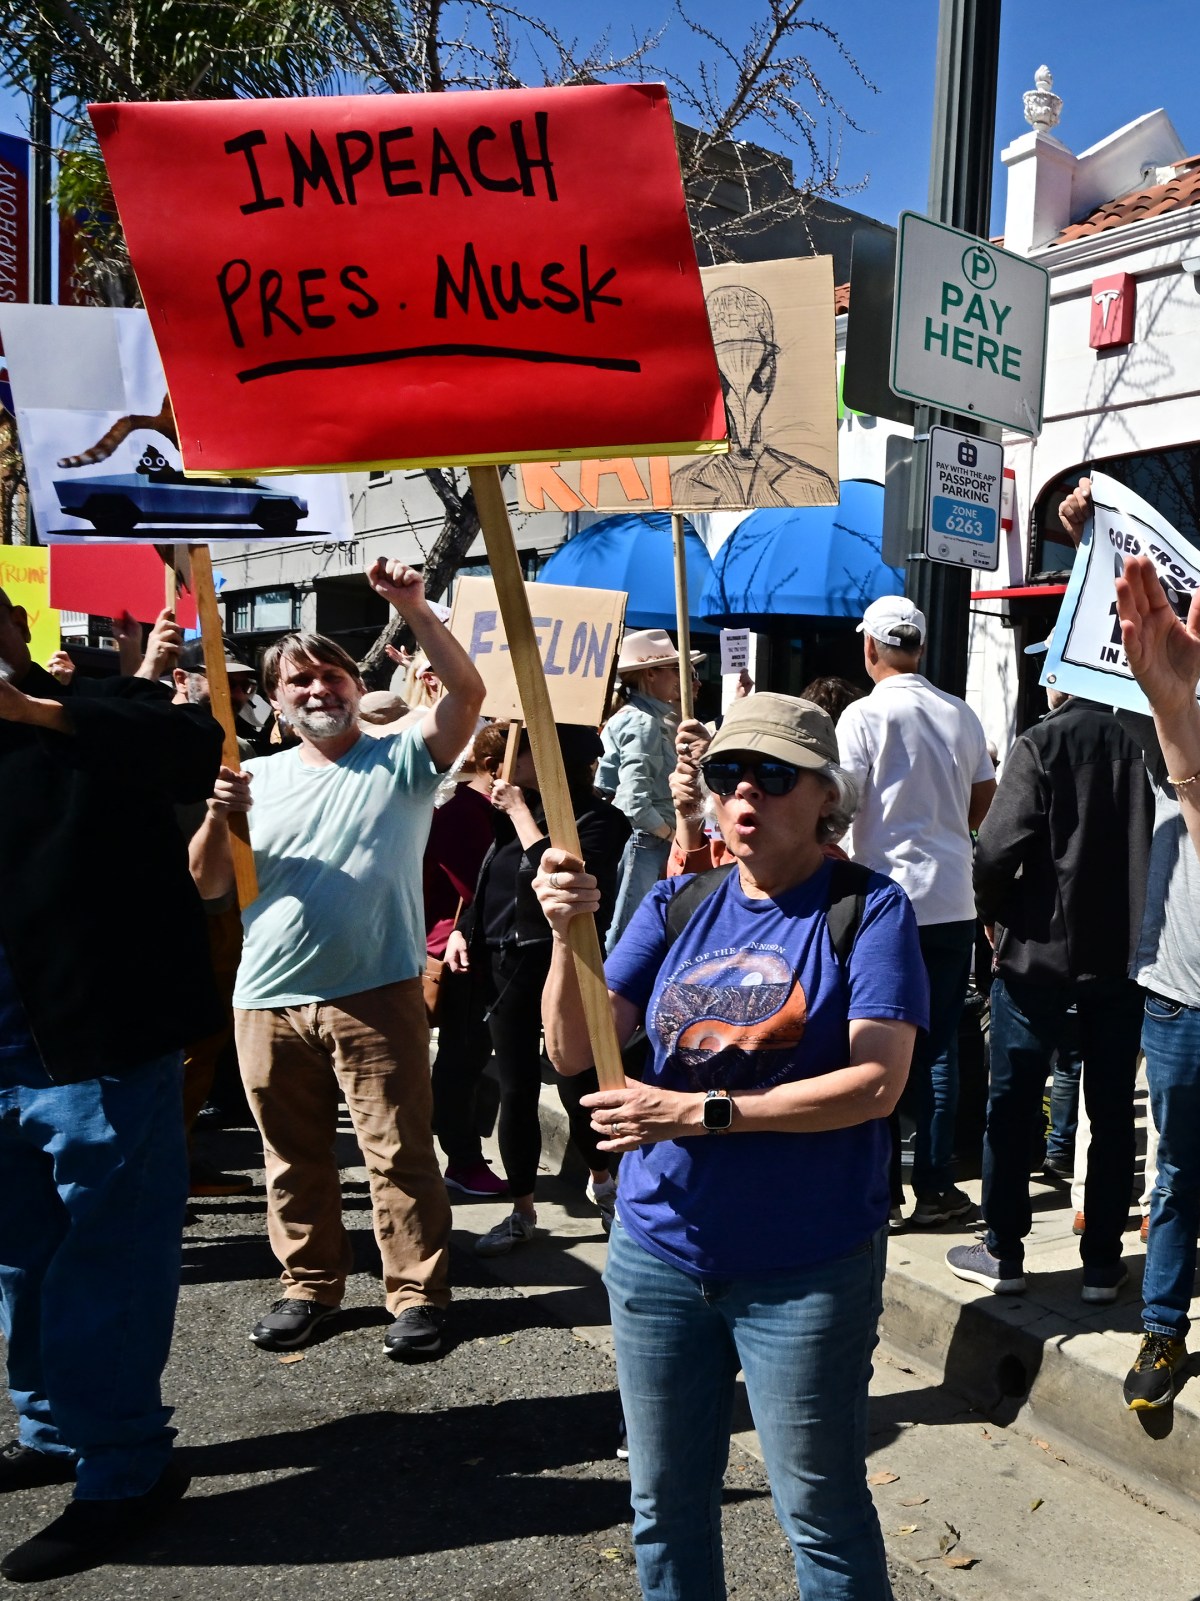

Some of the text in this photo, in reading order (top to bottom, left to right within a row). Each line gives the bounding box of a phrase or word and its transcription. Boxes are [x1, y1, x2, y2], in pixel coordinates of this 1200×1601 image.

[224, 111, 558, 215] IMPEACH
[216, 242, 623, 348] PRES. Musk
[941, 281, 1012, 336] PAY
[924, 316, 1023, 382] HERE
[936, 461, 997, 483] PAY WITH THE APP
[939, 470, 993, 493] PASSPORT
[942, 483, 990, 504] PARKING
[952, 505, 978, 519] ZONE
[945, 515, 983, 537] 6263
[1108, 527, 1141, 555] GOES
[1100, 646, 1120, 664] IN
[695, 951, 710, 963] OF
[712, 947, 737, 957] THE
